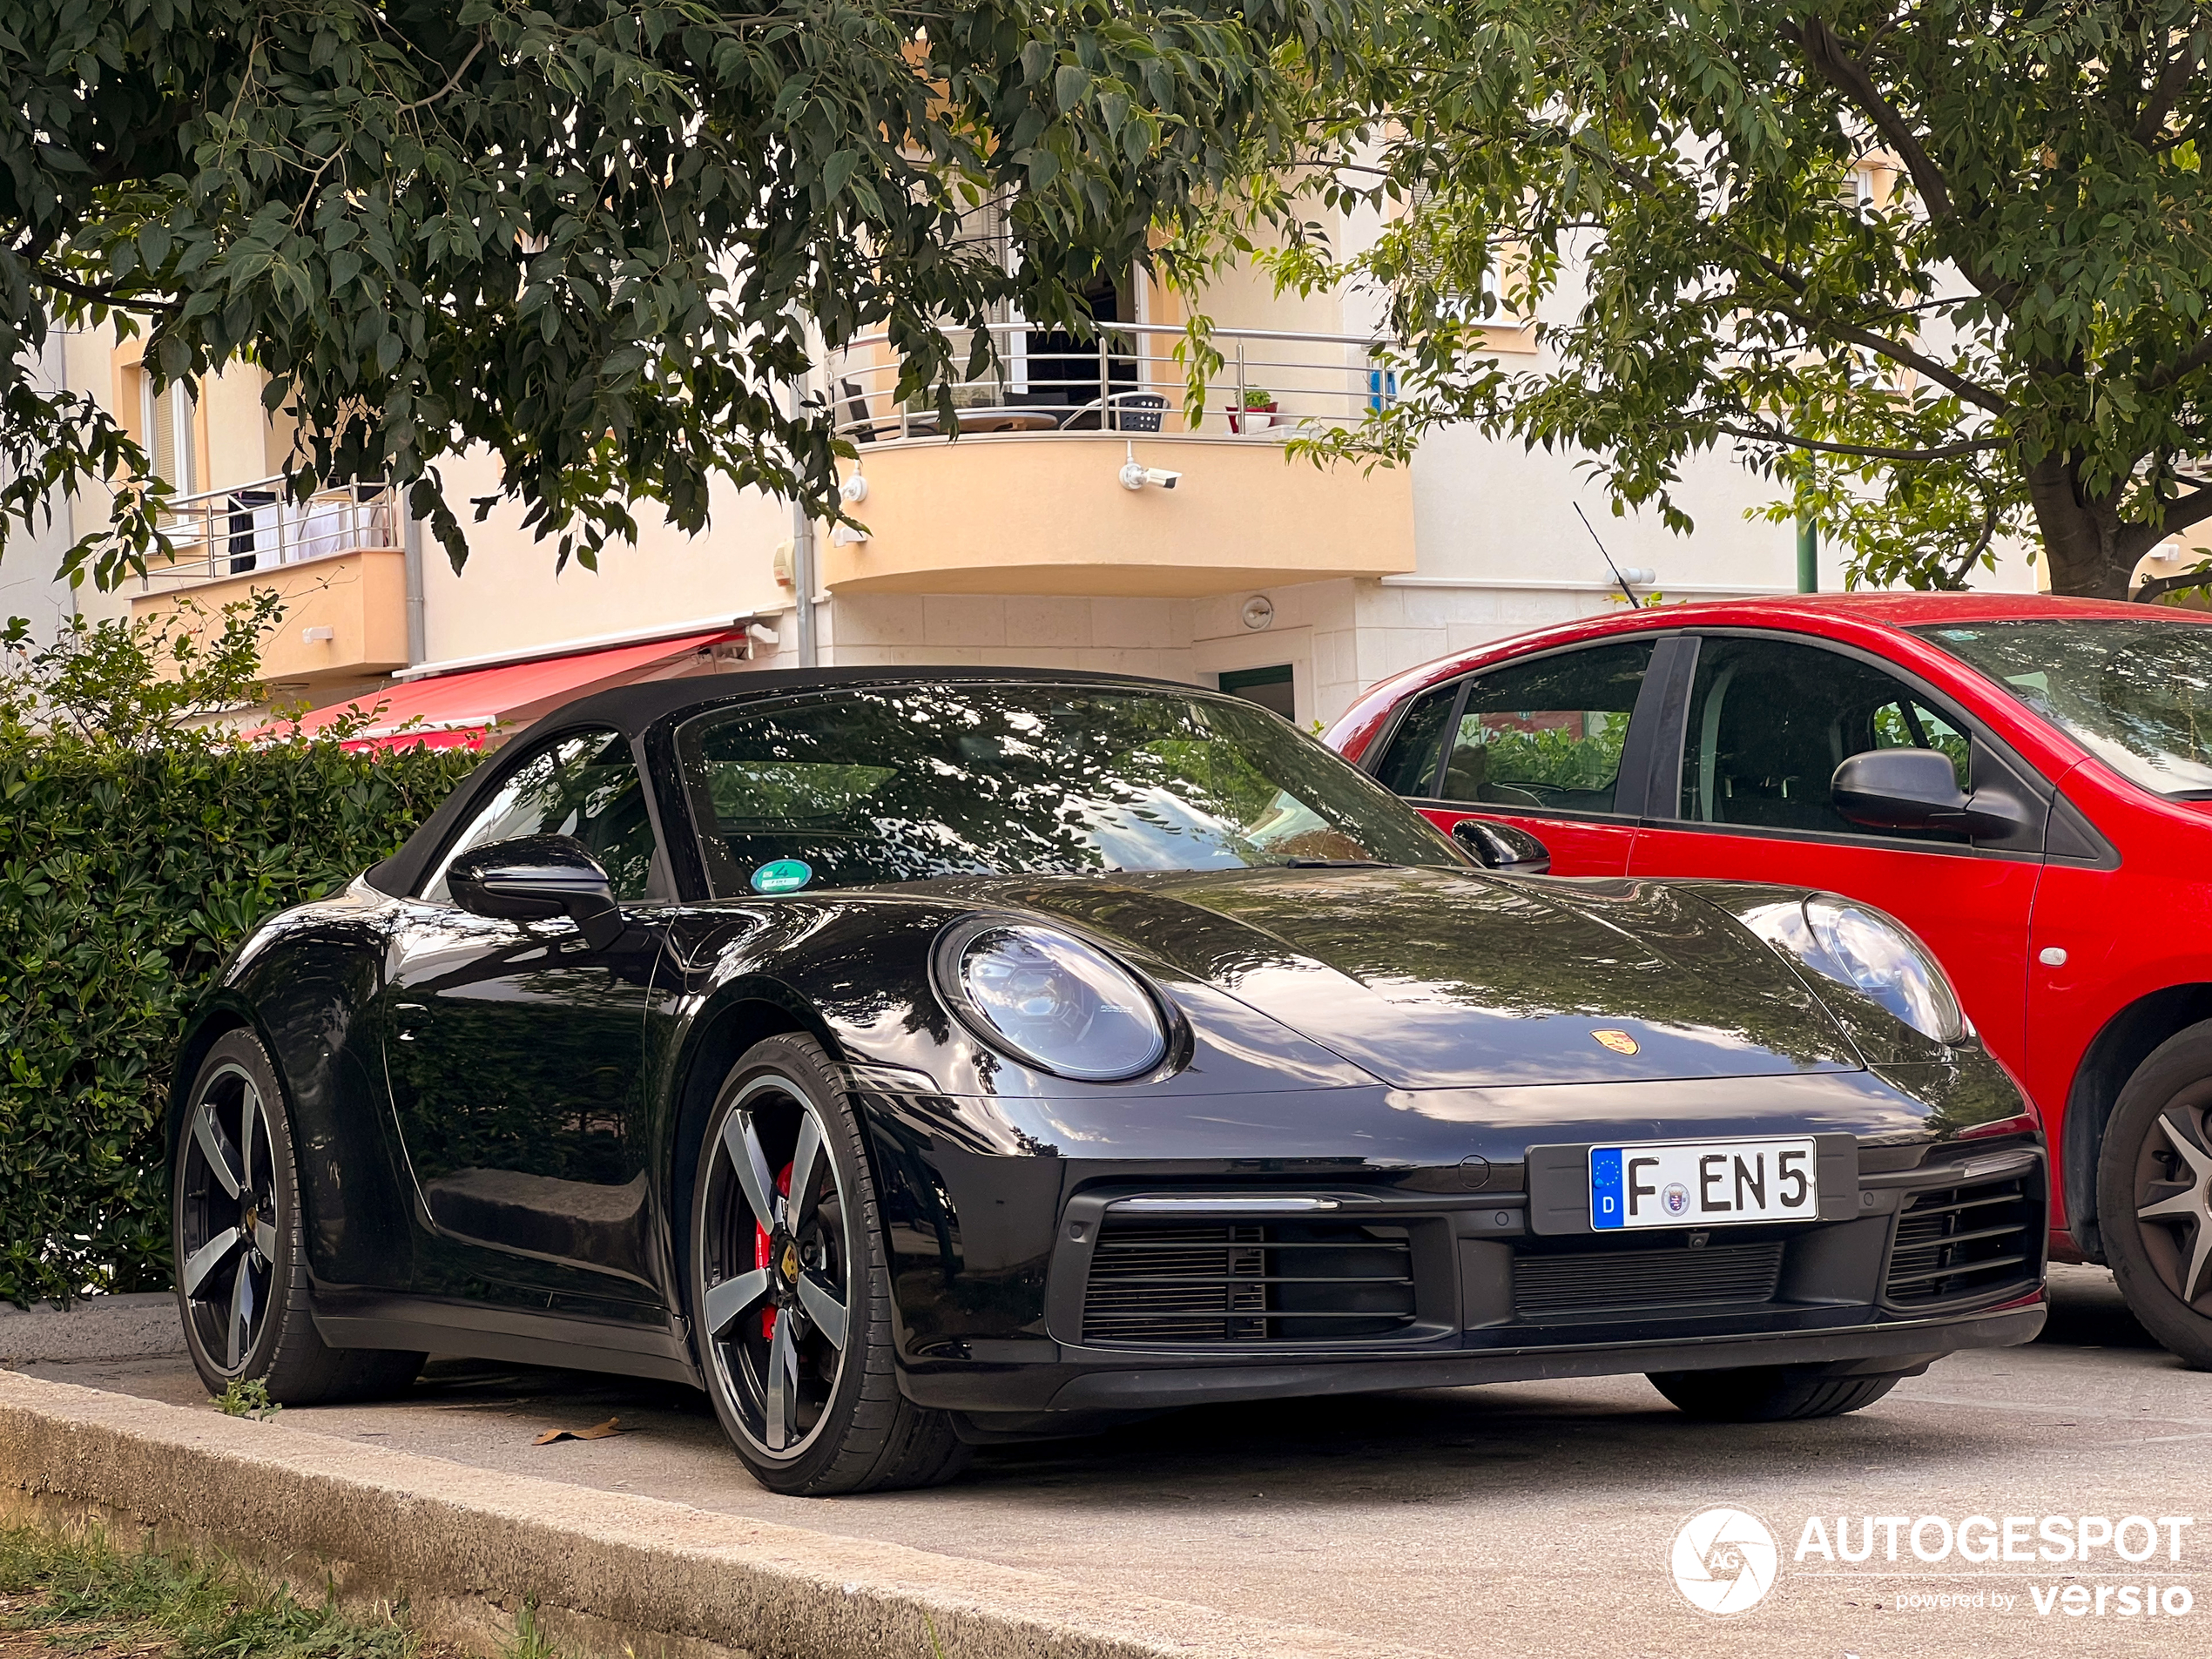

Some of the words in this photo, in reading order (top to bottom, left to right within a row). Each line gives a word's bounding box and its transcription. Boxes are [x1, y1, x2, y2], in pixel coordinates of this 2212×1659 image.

[774, 864, 789, 877] 4
[1628, 1157, 1660, 1216] F
[1699, 1151, 1766, 1212] EN
[1778, 1150, 1807, 1208] 5
[1602, 1196, 1615, 1214] D
